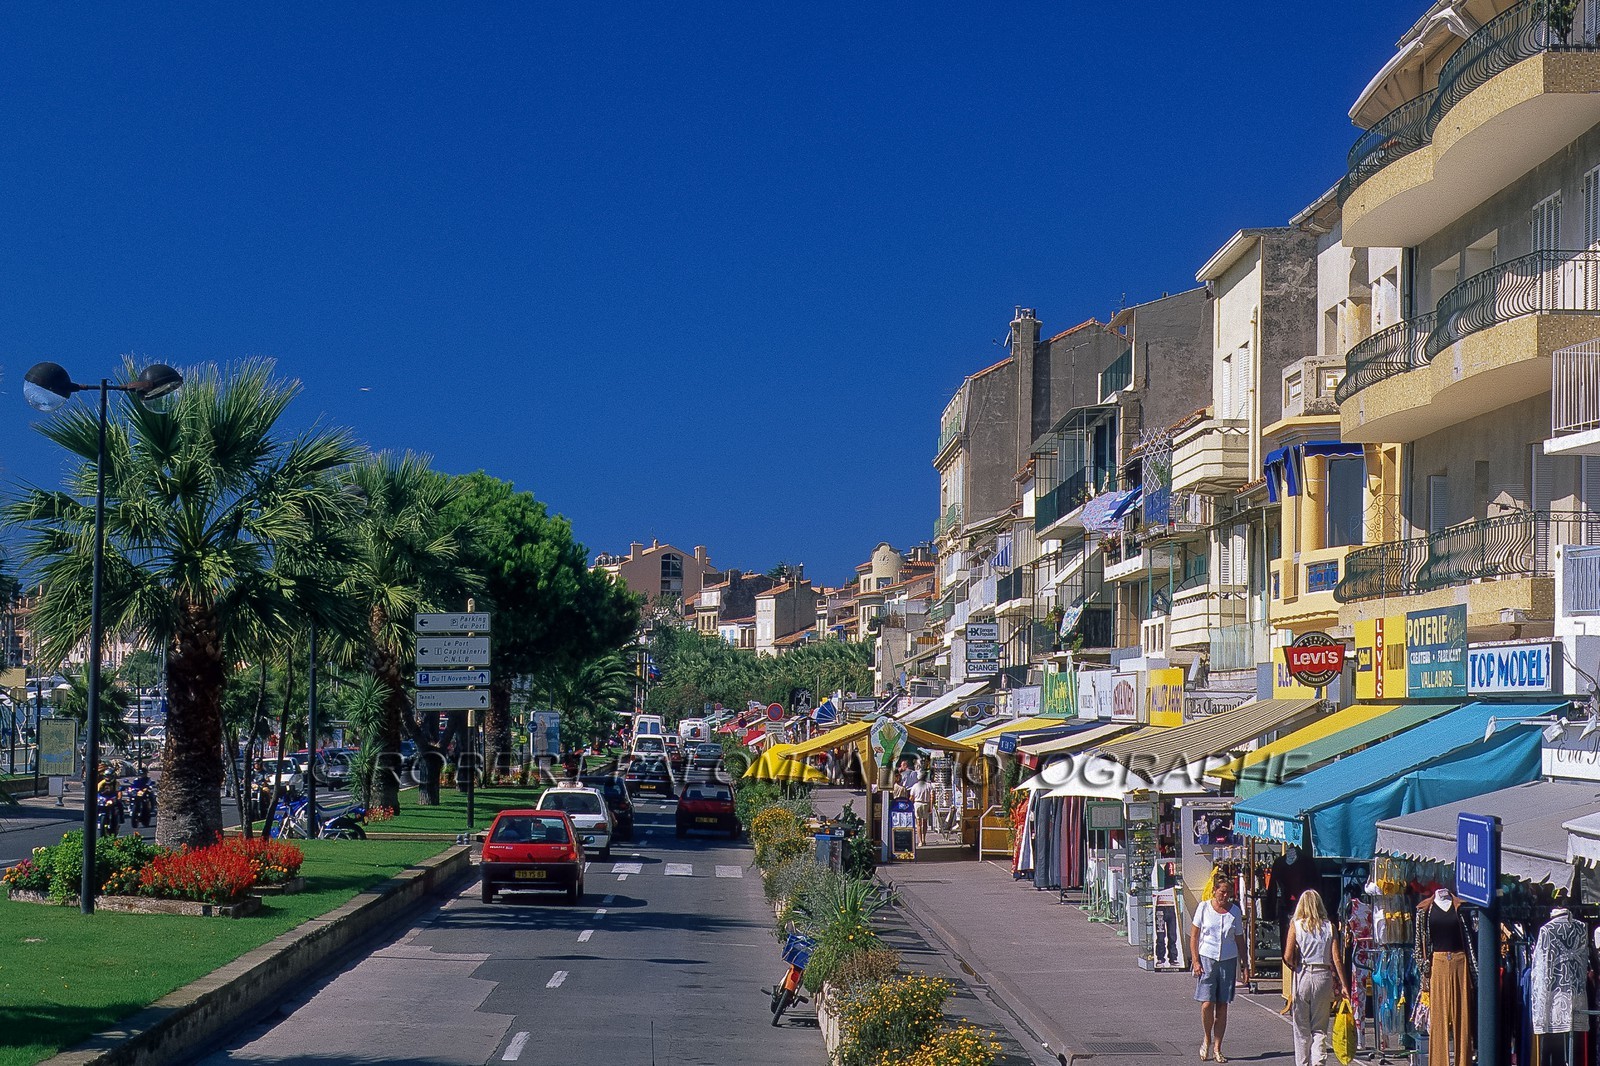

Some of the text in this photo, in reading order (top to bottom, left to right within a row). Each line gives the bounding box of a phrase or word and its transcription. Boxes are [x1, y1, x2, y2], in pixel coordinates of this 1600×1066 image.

[1407, 614, 1448, 647] POTERIE
[443, 648, 487, 656] Capitainerie
[446, 673, 477, 681] Novembre
[1421, 670, 1452, 688] VALLAURIS
[1470, 650, 1544, 688] TOP MODEL
[1190, 699, 1202, 714] La
[1258, 816, 1268, 836] TOP
[1270, 818, 1286, 840] MODEL
[1467, 832, 1479, 854] QUAI
[1460, 862, 1486, 888] DE GAULLE
